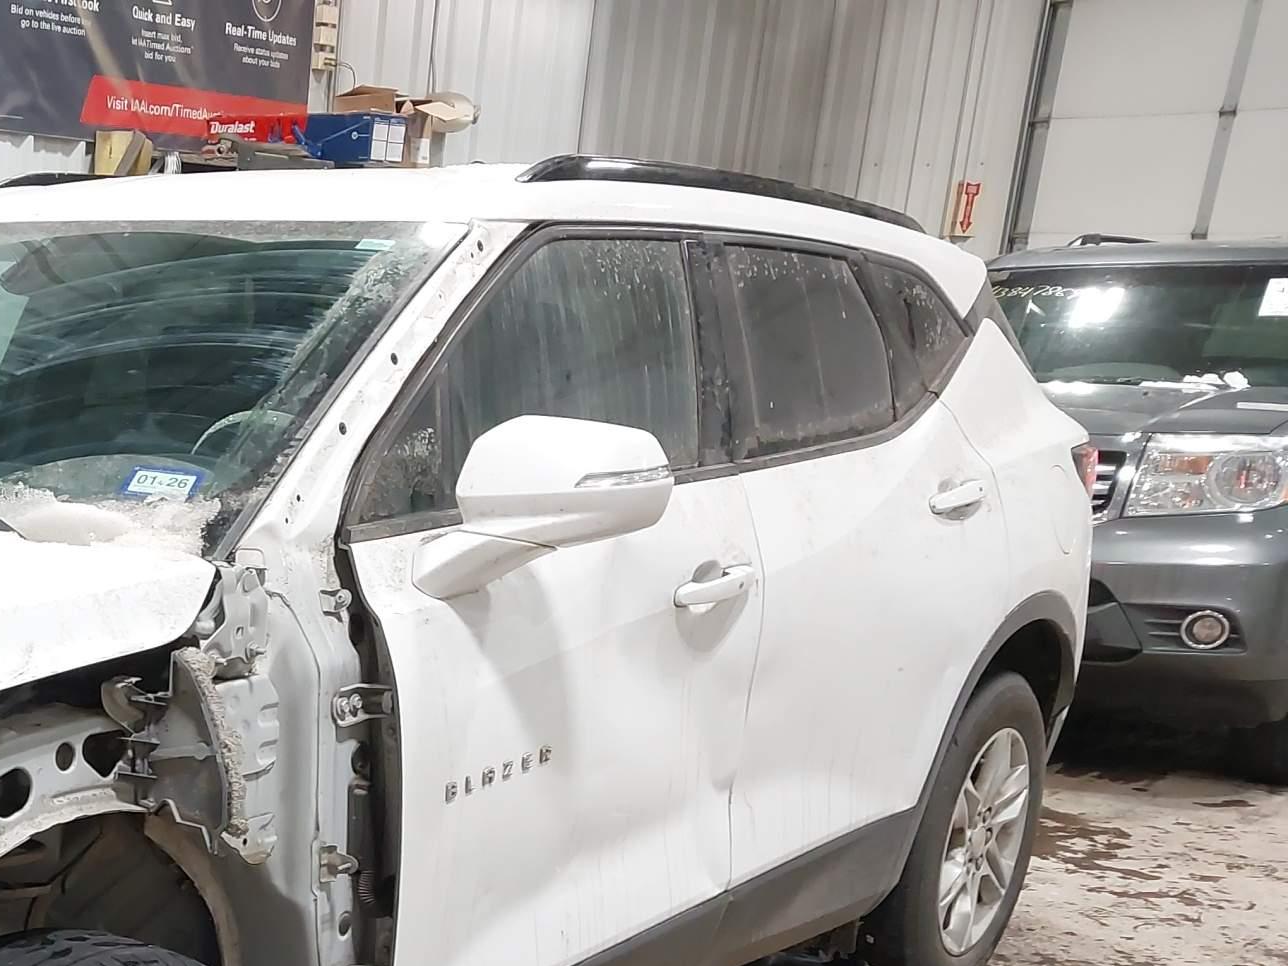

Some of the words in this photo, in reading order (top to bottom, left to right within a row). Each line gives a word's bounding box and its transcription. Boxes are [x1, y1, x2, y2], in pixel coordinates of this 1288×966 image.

[10, 4, 23, 15] Bid
[24, 8, 34, 17] on
[35, 9, 59, 21] vehicles
[60, 13, 81, 25] before
[132, 6, 153, 22] Quick
[155, 12, 172, 25] and
[175, 13, 196, 32] Easy
[20, 19, 30, 29] go
[31, 20, 39, 29] to
[40, 20, 50, 30] the
[51, 22, 61, 33] live
[62, 26, 86, 37] auction
[225, 22, 267, 41] Real-Time
[268, 30, 297, 47] Updates
[144, 50, 153, 60] bid
[154, 51, 164, 61] for
[165, 55, 177, 63] you
[107, 95, 128, 111] Visit
[209, 121, 255, 134] Duralast
[444, 745, 552, 804] BLAZER
